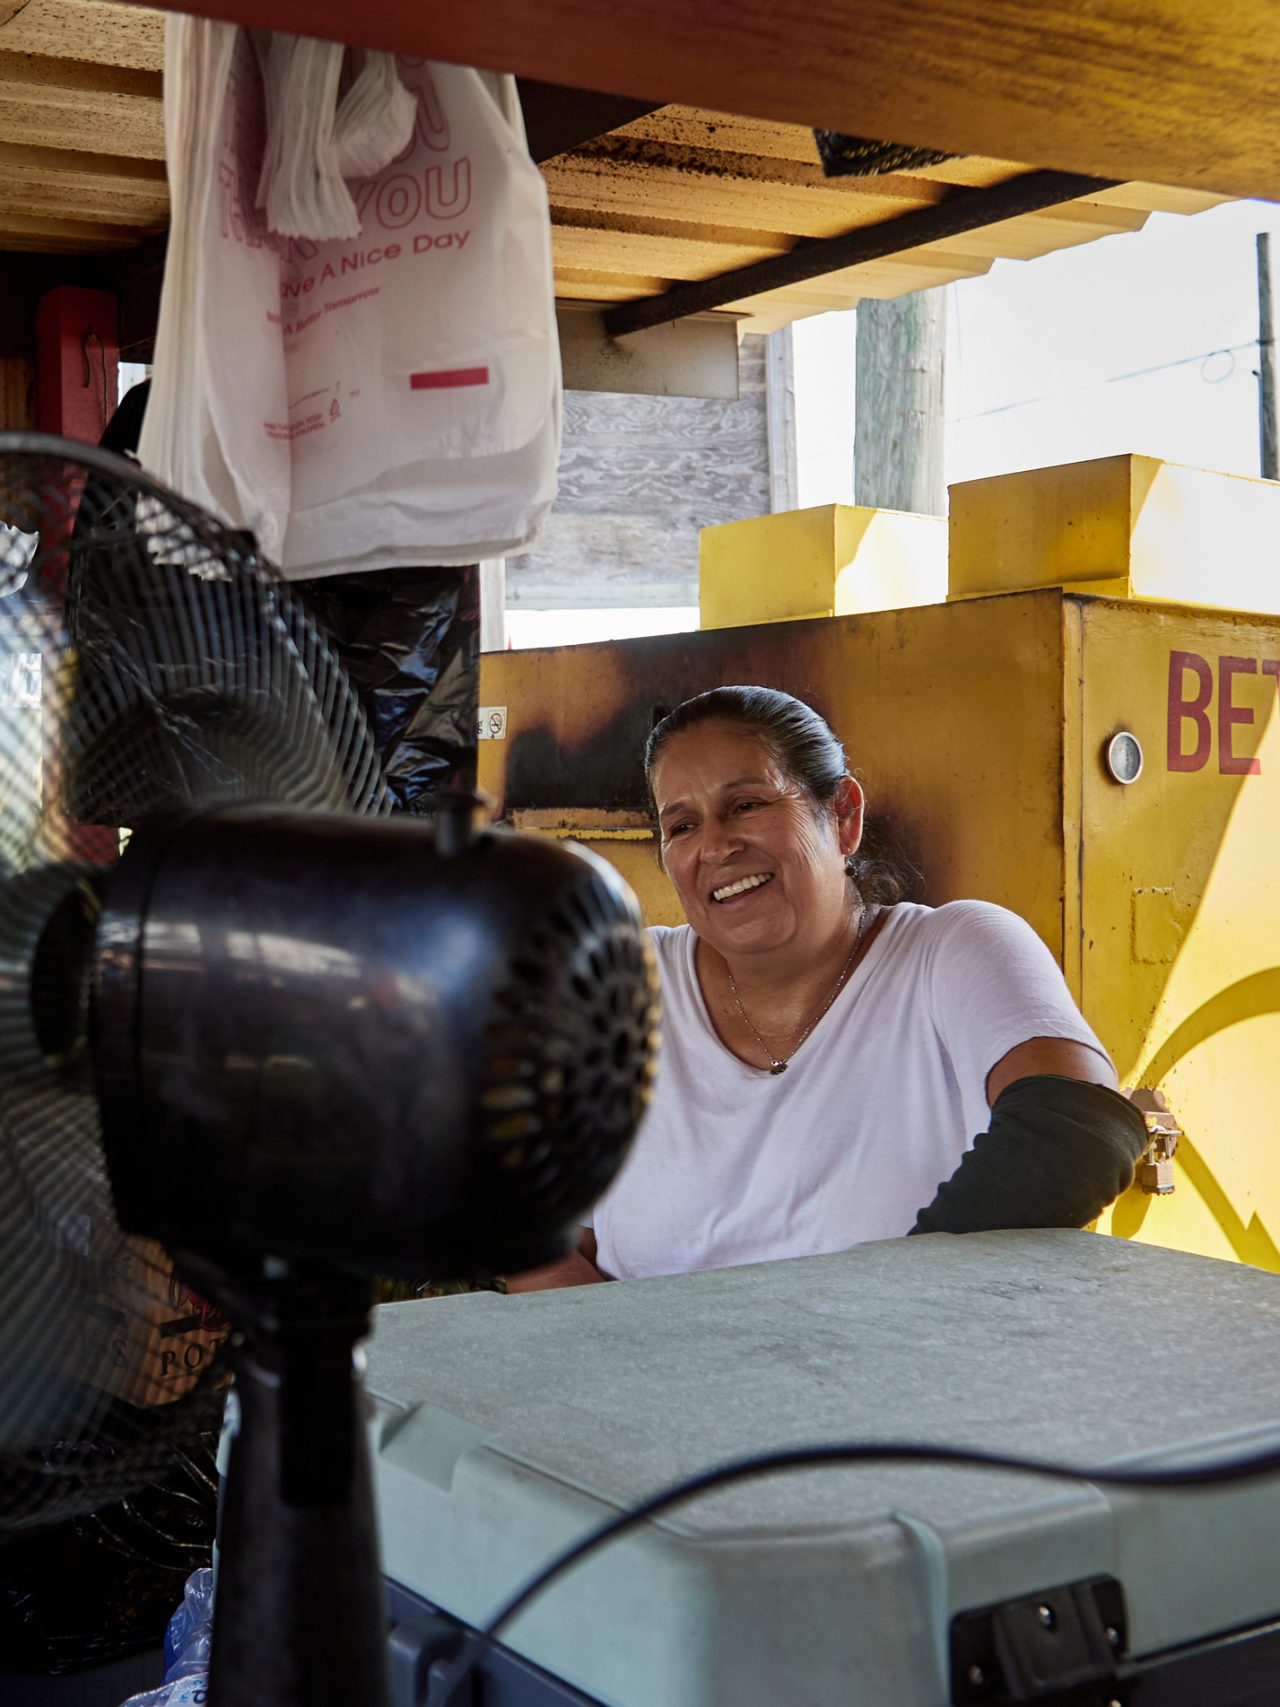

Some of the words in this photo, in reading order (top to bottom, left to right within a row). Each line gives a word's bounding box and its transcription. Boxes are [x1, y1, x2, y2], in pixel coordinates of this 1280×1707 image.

[280, 279, 315, 300] ave
[319, 263, 336, 284] A
[341, 233, 401, 274] Nice
[413, 228, 471, 257] Day
[324, 286, 381, 313] Tomorrow
